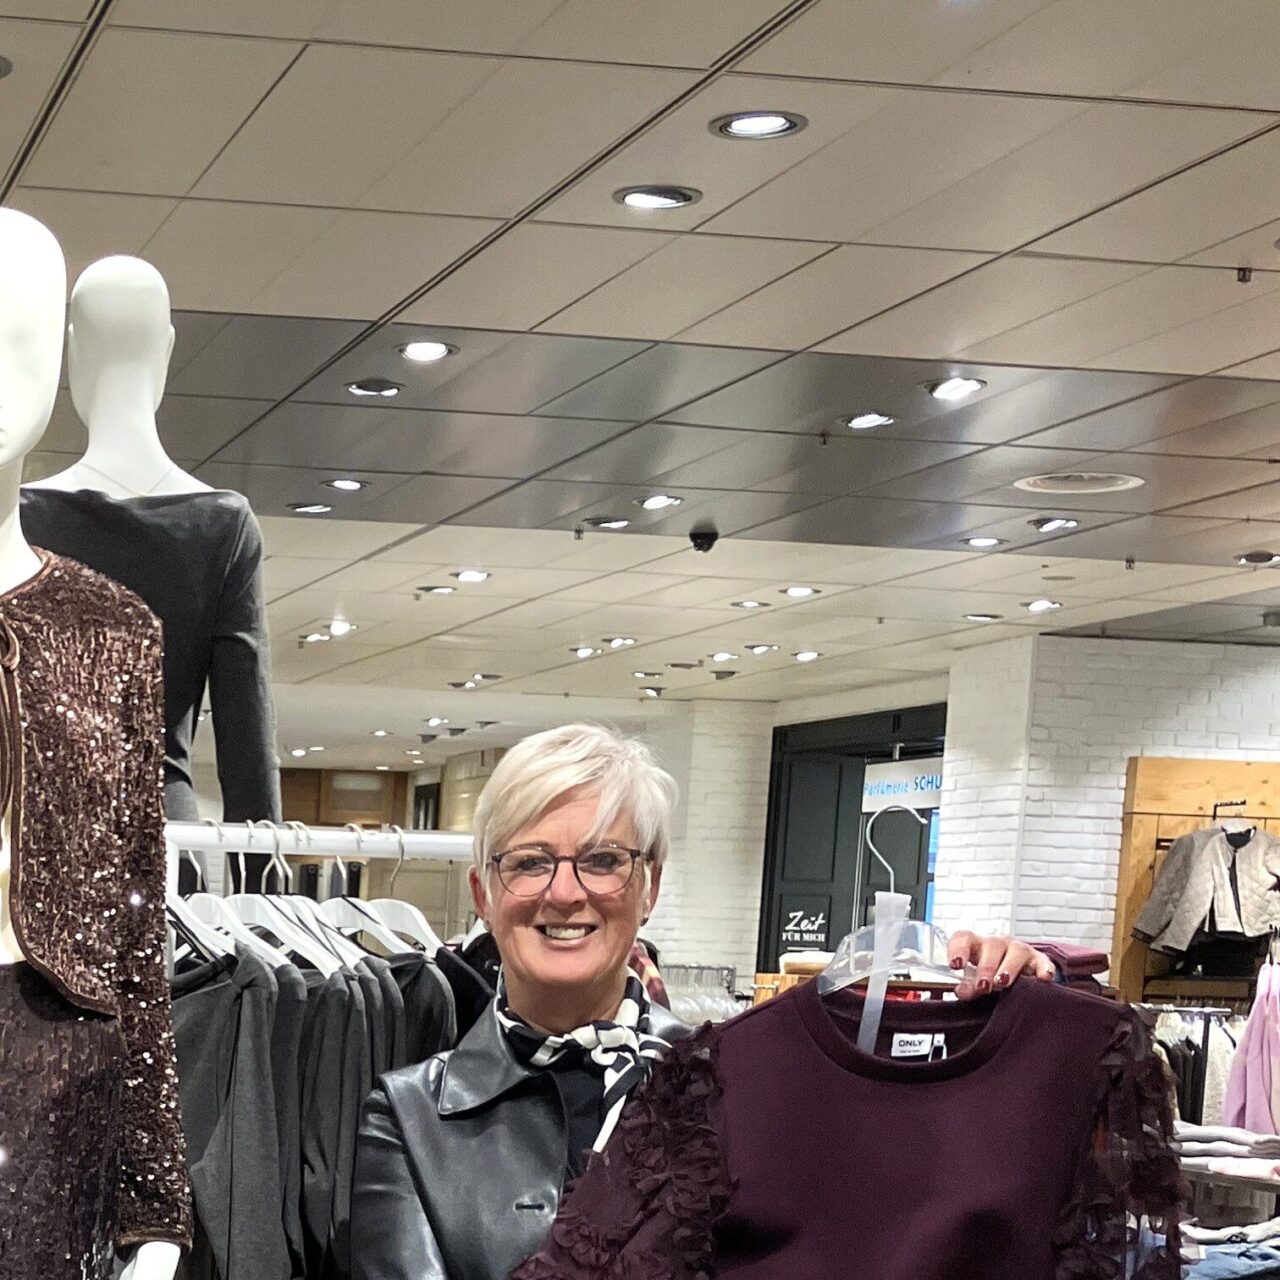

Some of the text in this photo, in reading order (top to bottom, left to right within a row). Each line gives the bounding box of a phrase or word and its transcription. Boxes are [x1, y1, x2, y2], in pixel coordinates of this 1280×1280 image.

[784, 911, 826, 931] Zeit
[782, 931, 825, 942] FÜR MICH
[898, 1039, 924, 1047] ONLY
